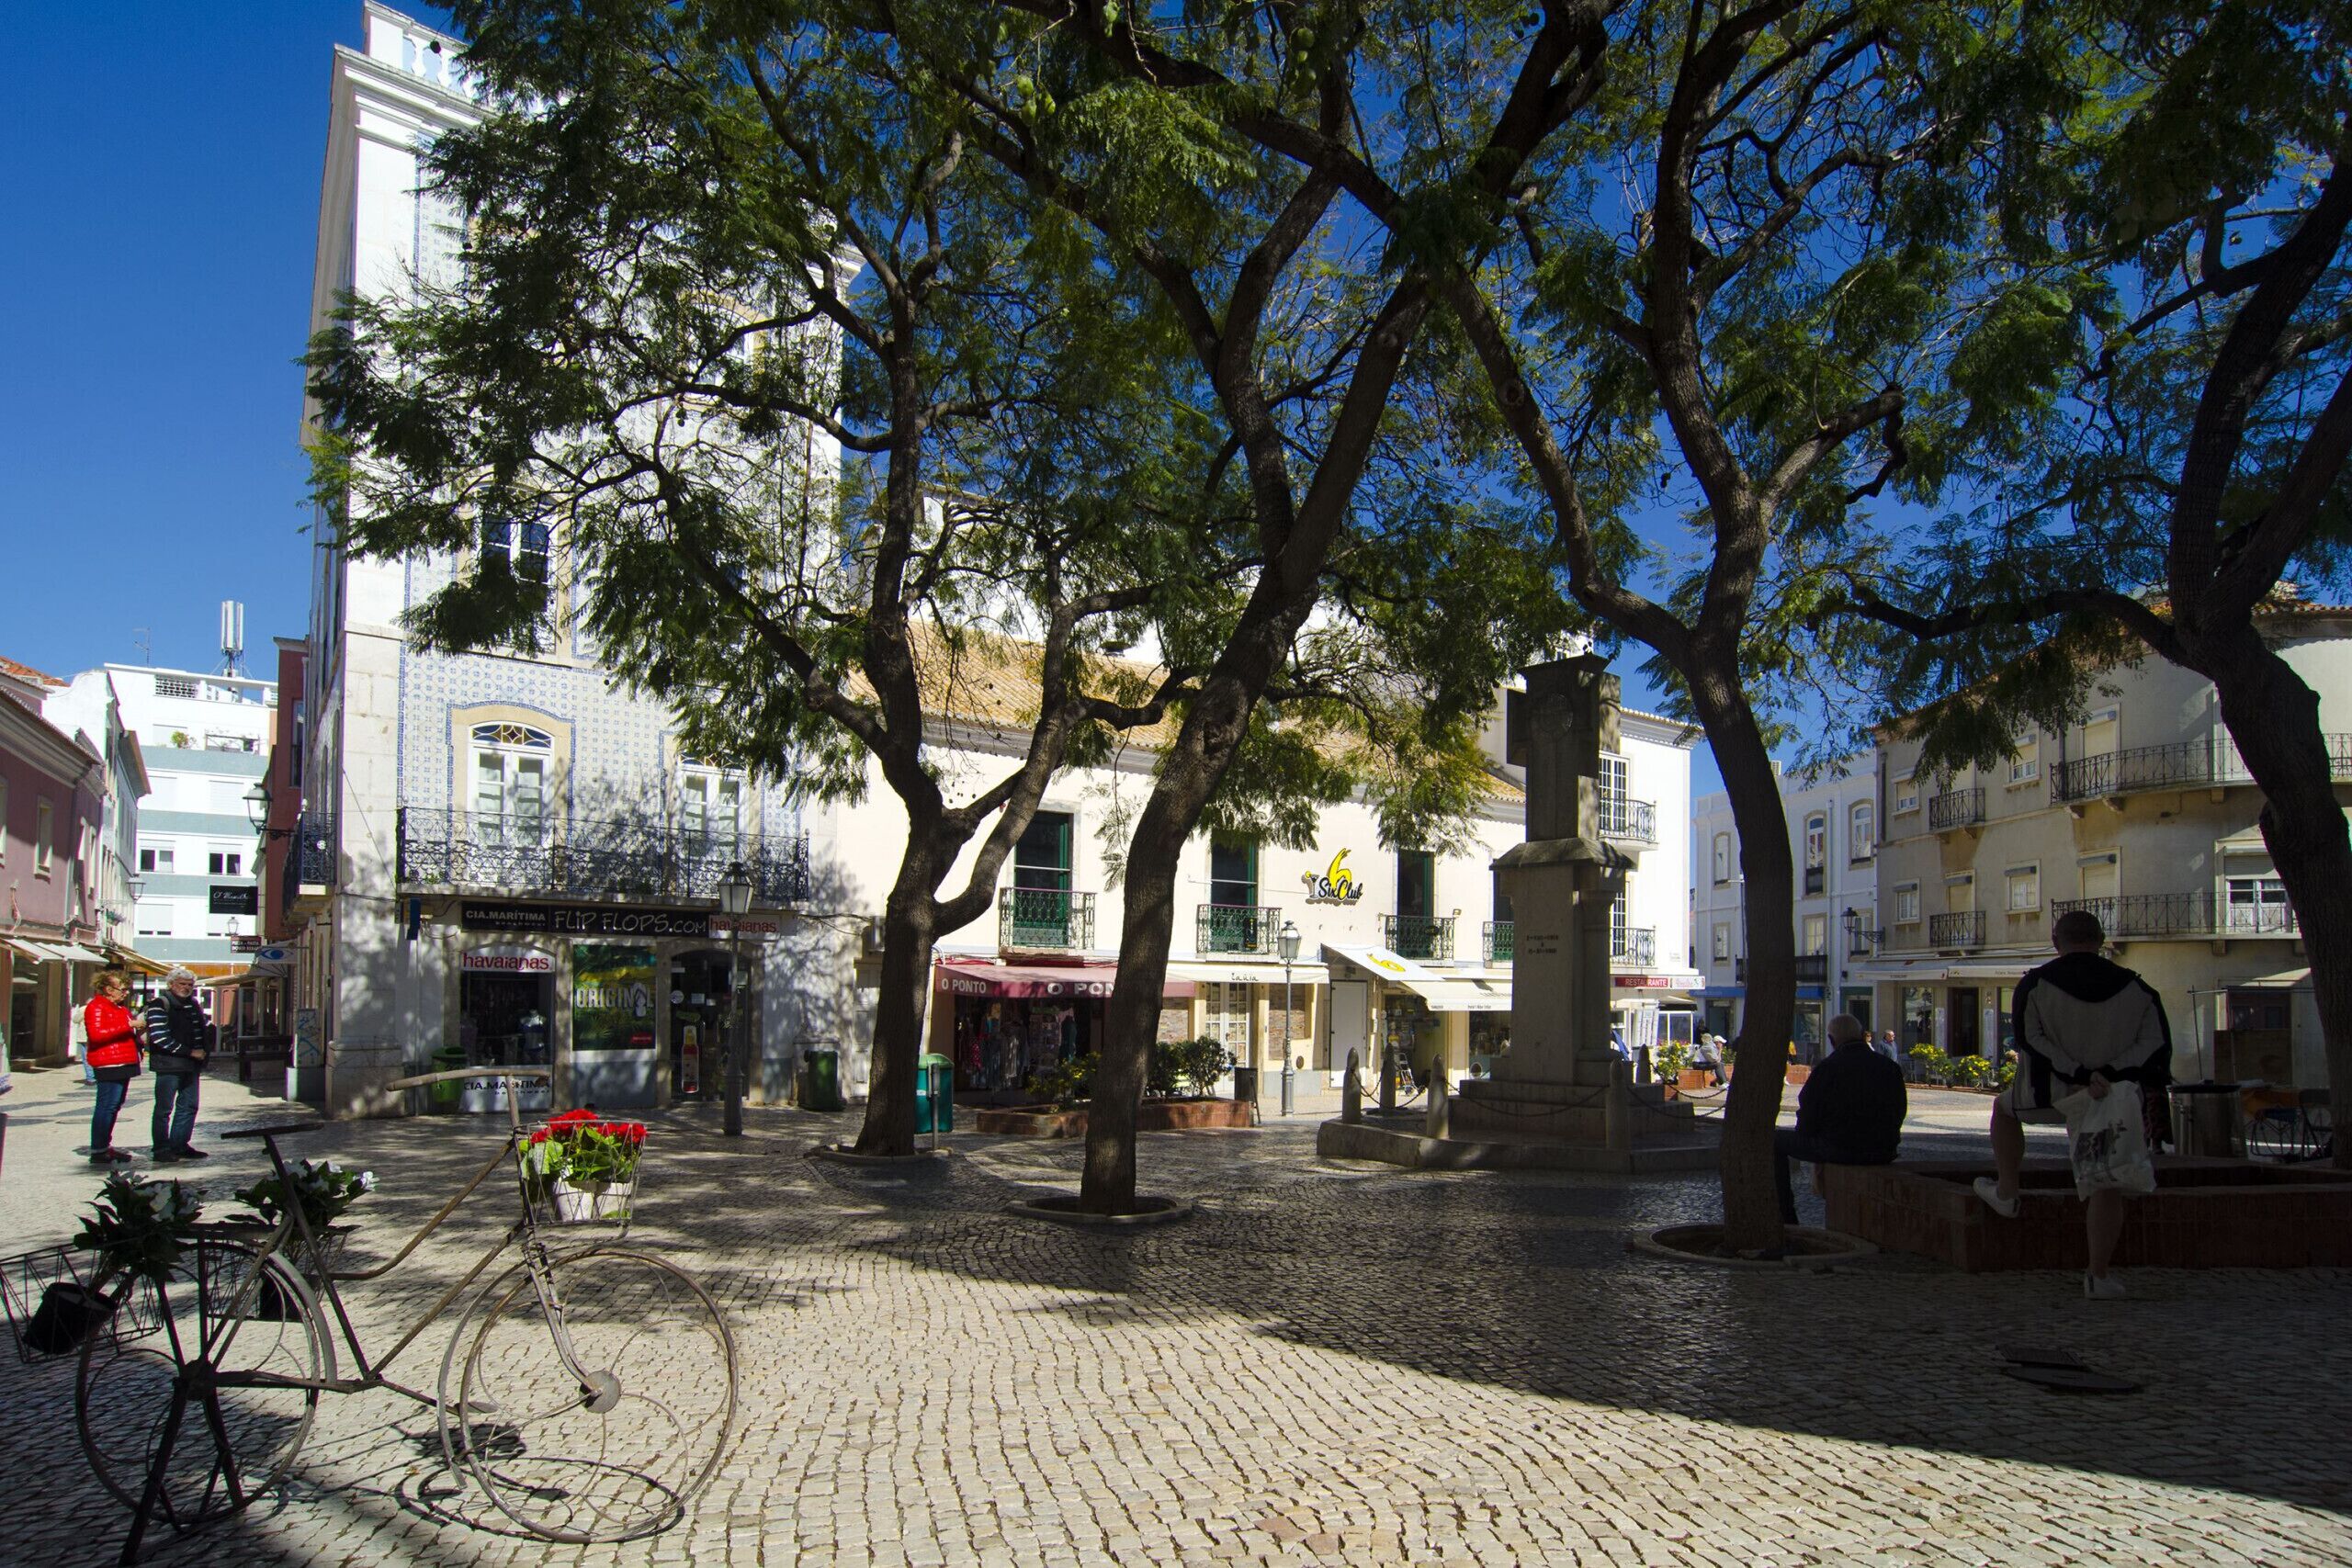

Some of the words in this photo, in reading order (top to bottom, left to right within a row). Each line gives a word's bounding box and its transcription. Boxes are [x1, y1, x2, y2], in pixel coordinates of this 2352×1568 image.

[466, 909, 546, 921] CIA.MARÍTIMA
[463, 953, 549, 971] havaianas
[942, 978, 949, 990] O
[952, 979, 986, 994] PONTO
[1047, 982, 1063, 995] O
[1074, 983, 1114, 998] PON
